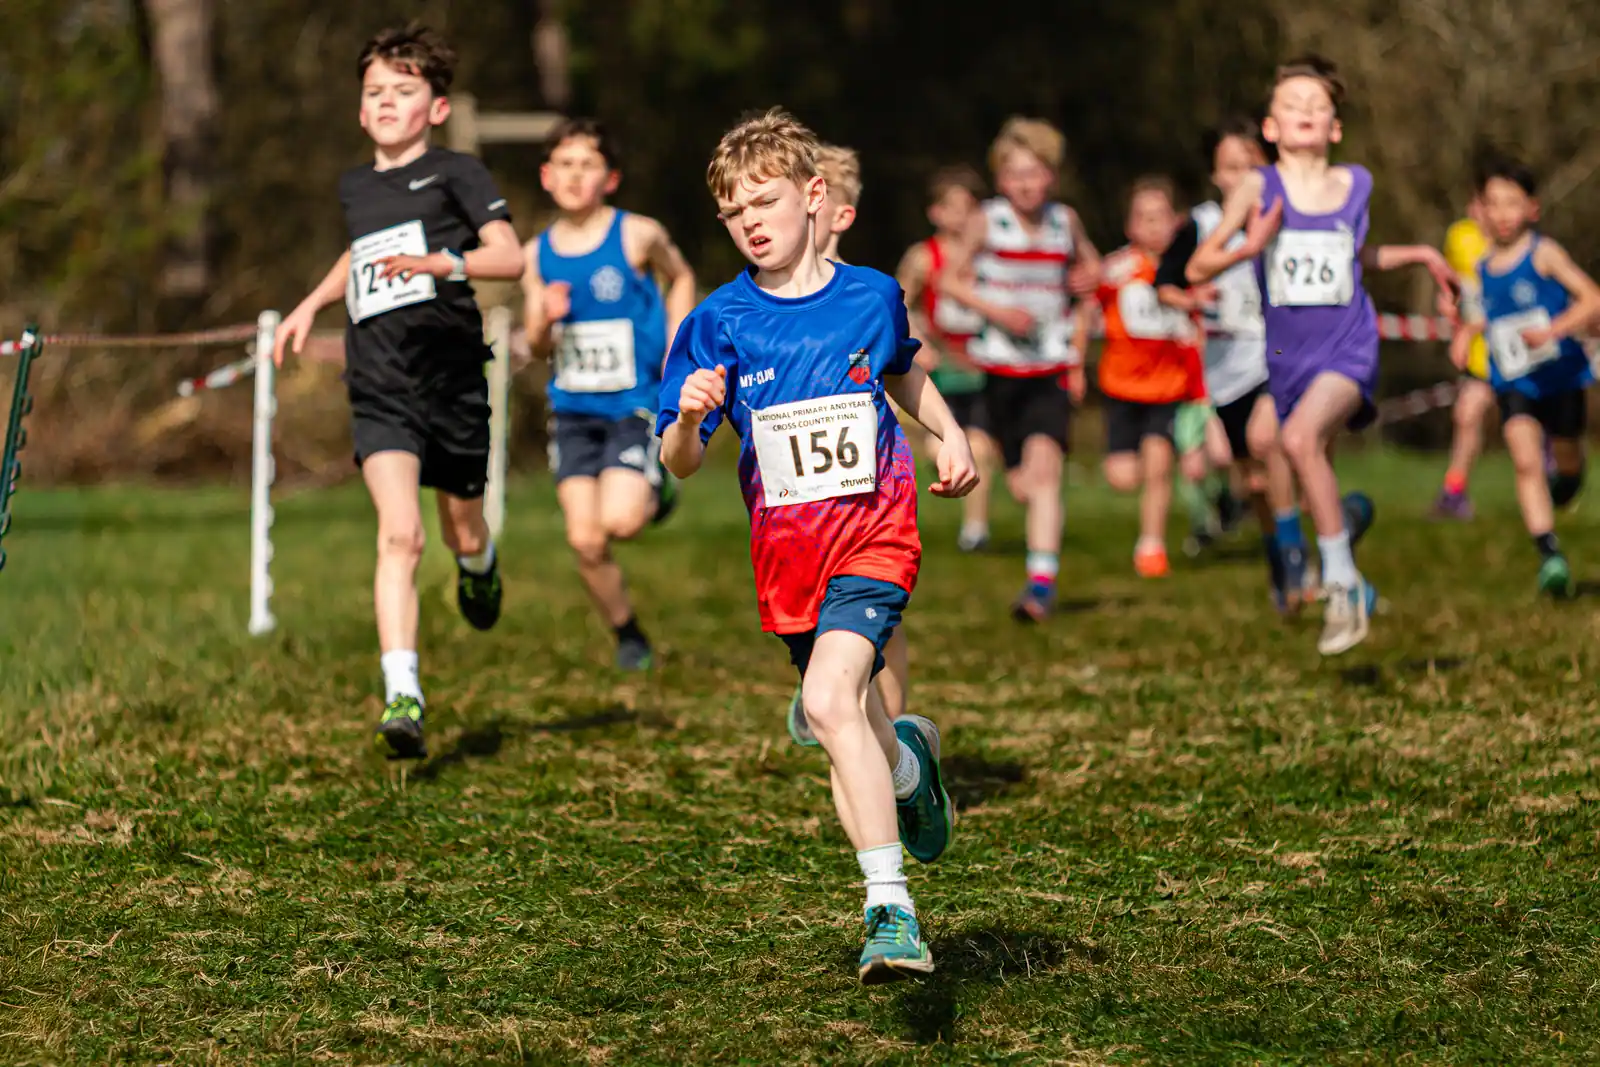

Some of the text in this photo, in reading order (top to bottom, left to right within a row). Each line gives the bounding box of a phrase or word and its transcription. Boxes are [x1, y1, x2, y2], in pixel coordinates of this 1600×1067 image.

[1284, 256, 1334, 286] 926
[757, 411, 791, 422] NATIONAL
[792, 405, 828, 417] PRIMARY
[830, 402, 847, 410] AND
[848, 400, 866, 409] YEAR
[772, 412, 859, 432] CROSS COUNTRY FINAL
[789, 426, 860, 477] 156
[840, 473, 876, 488] stuweb
